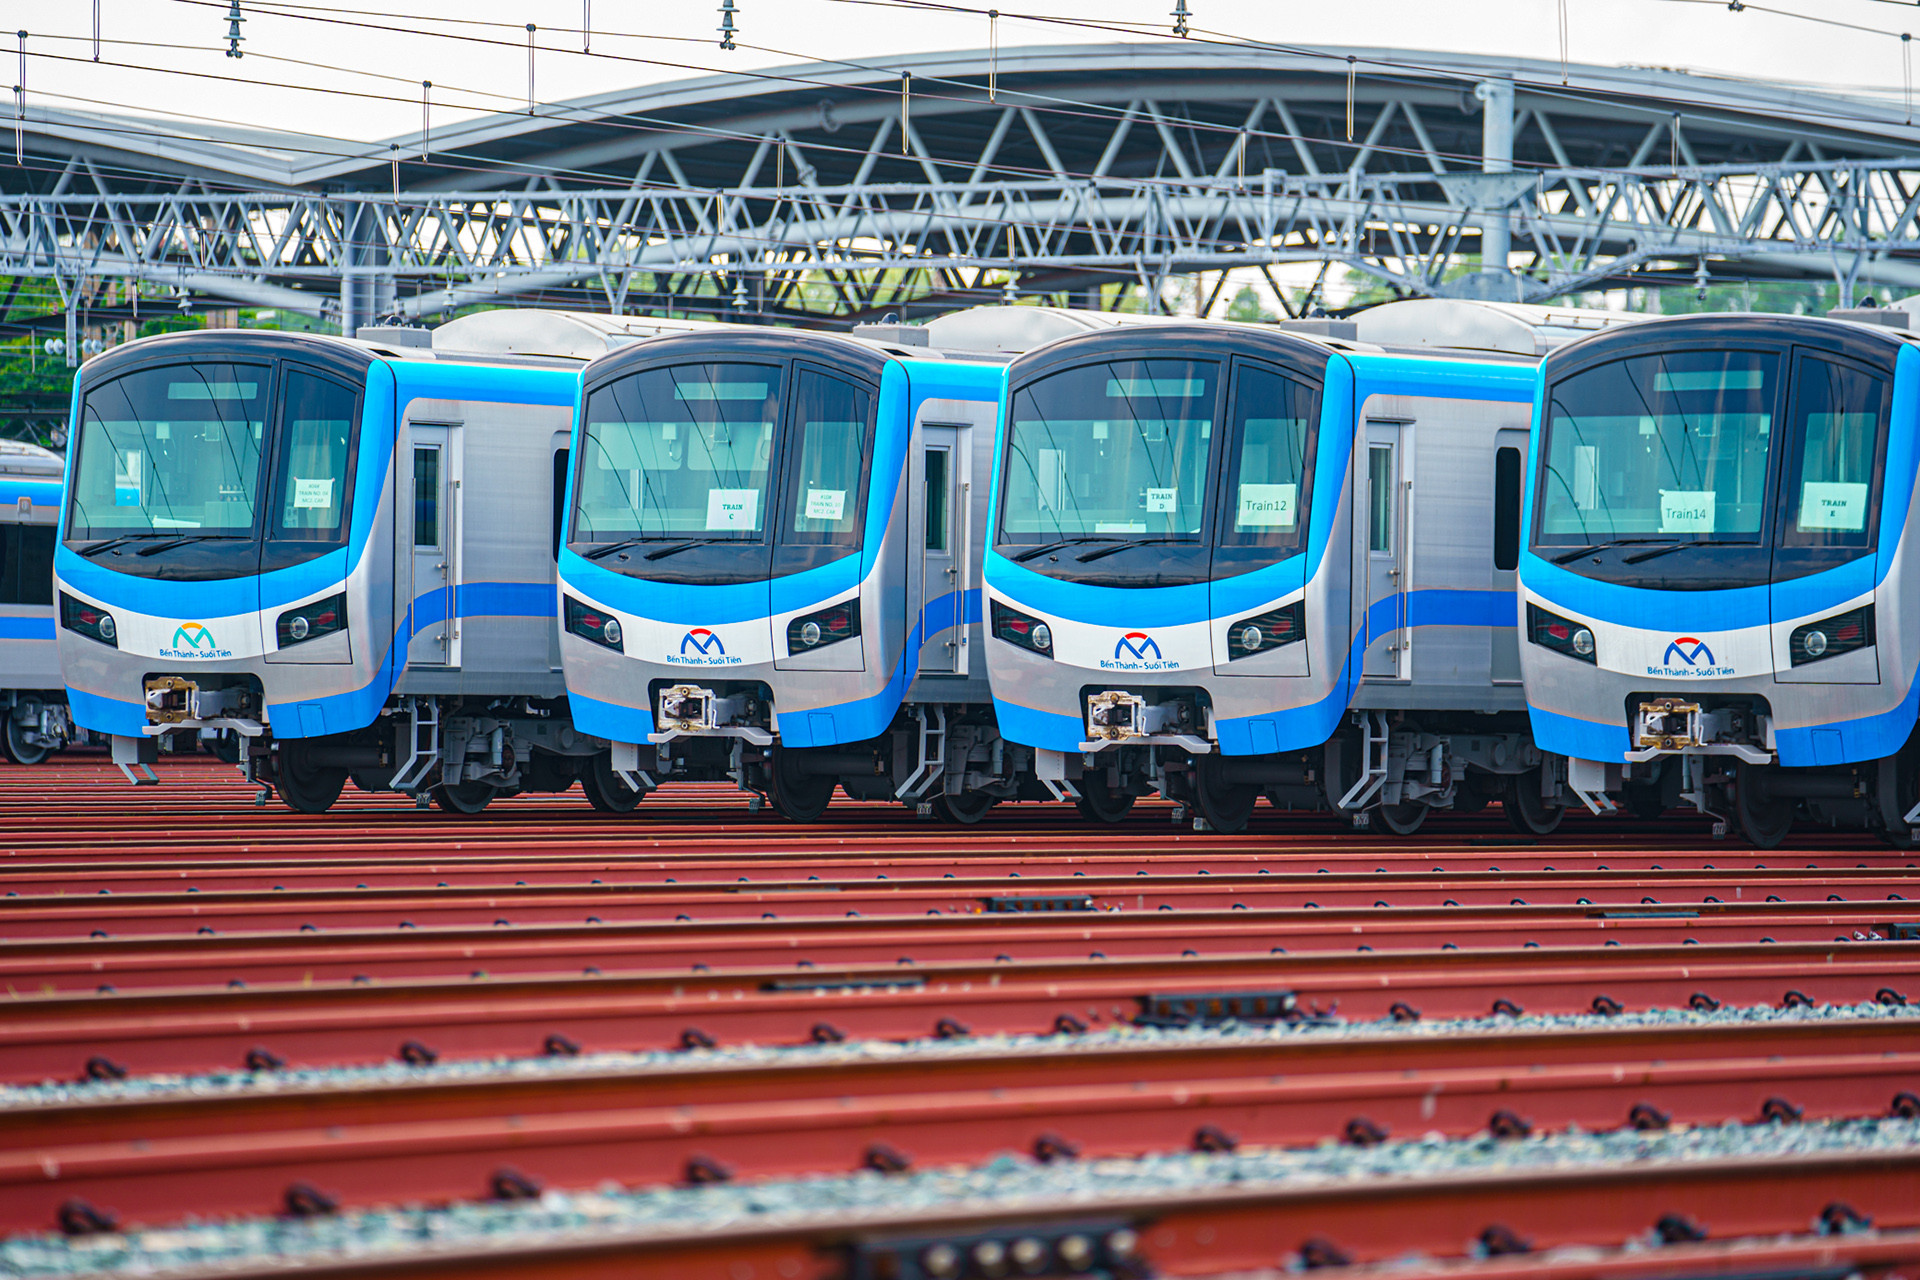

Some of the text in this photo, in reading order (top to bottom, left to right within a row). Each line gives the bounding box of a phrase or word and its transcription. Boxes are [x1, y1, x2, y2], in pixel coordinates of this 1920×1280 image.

[1246, 500, 1286, 511] Train12
[1666, 508, 1706, 520] Train14
[1648, 666, 1662, 675] Bến
[1696, 668, 1715, 676] Suối
